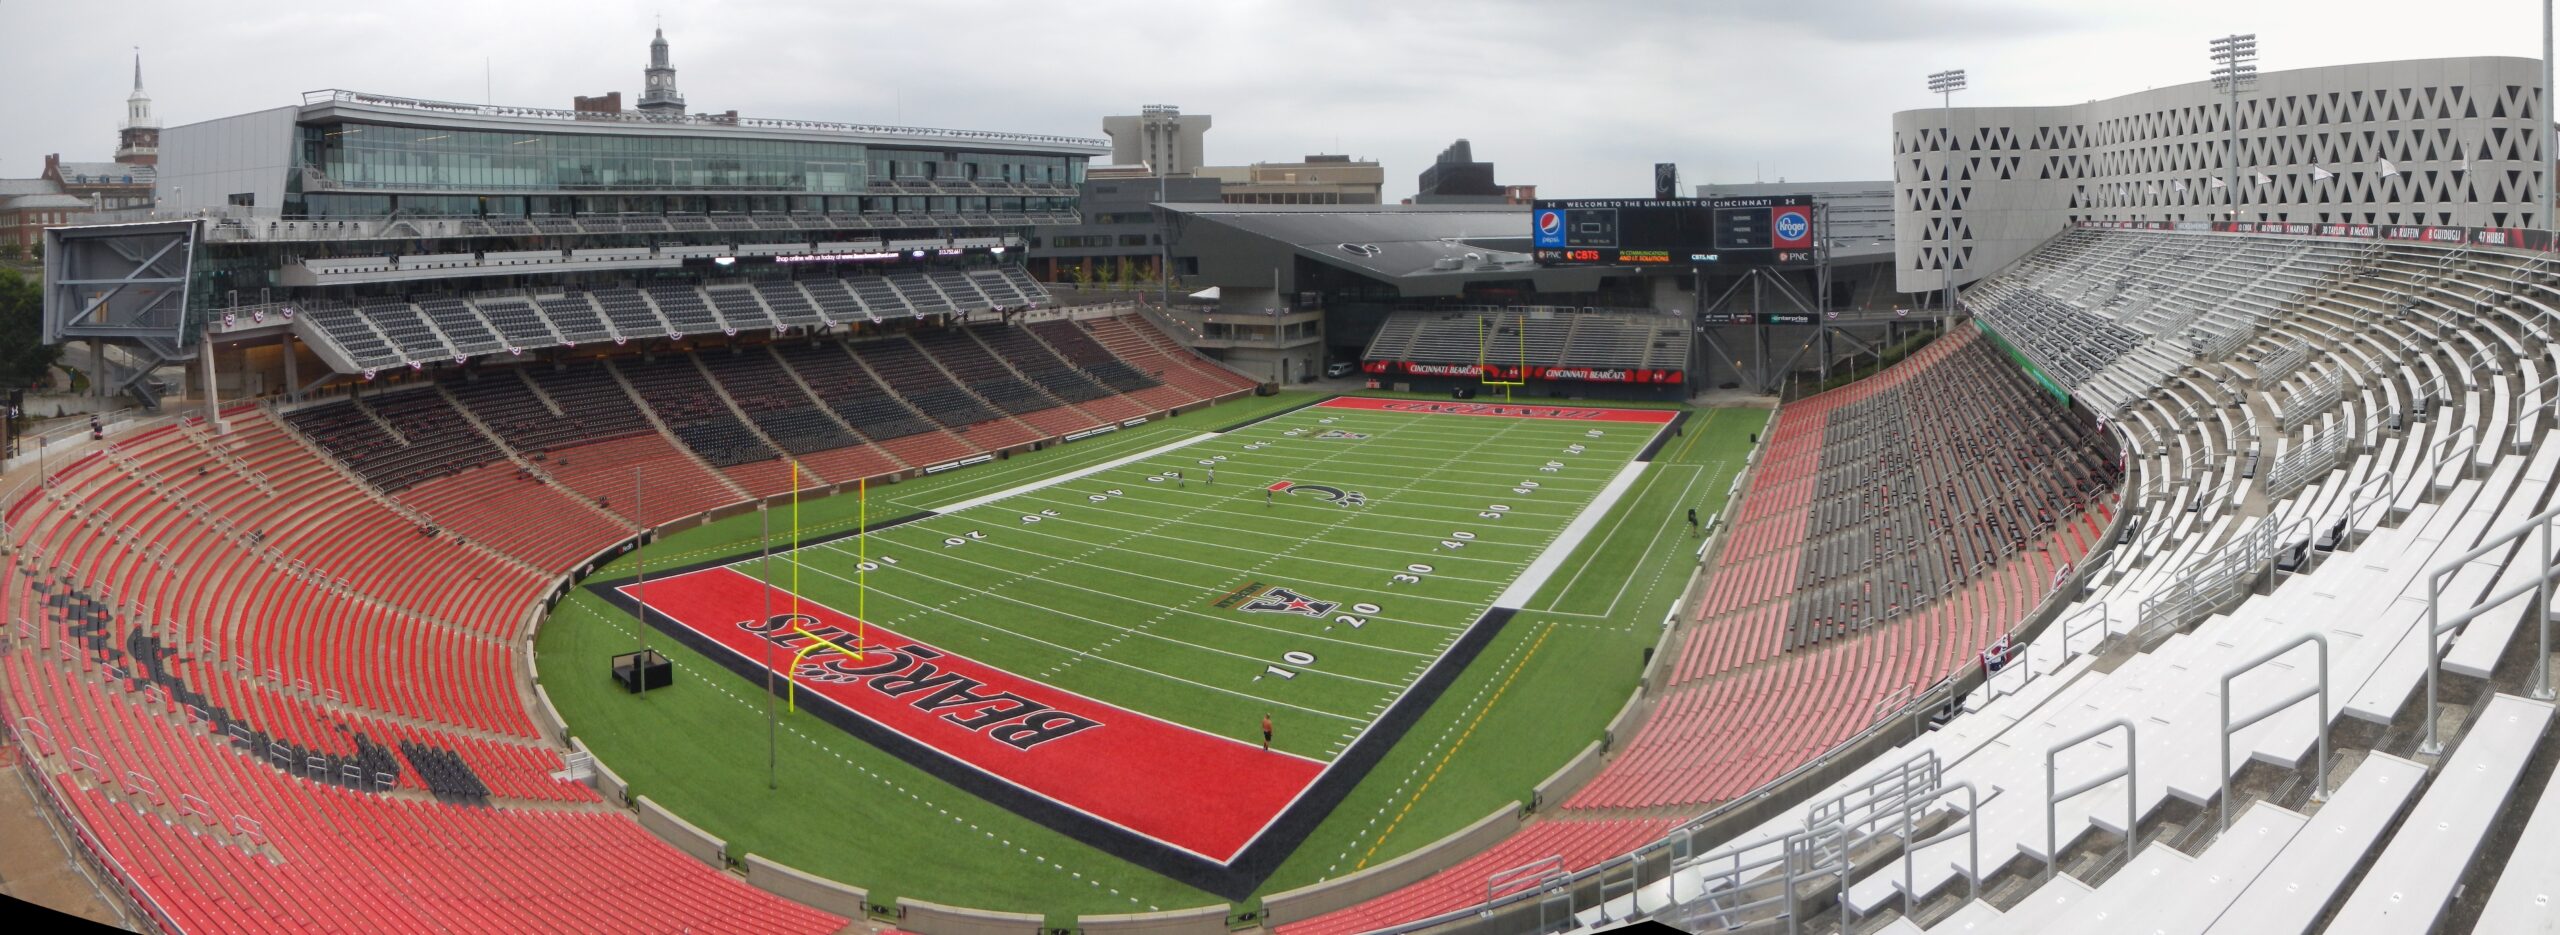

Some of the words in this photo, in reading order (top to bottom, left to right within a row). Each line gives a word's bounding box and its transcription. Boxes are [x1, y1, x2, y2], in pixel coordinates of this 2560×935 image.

[1714, 199, 1772, 207] CINCINNATI
[1780, 217, 1805, 237] Kroger
[2329, 227, 2345, 236] TAYLOR
[2399, 228, 2419, 238] RUFFIN
[2433, 229, 2461, 241] GUIDUGLI
[2478, 231, 2485, 242] 47
[2486, 232, 2505, 244] HUBER
[775, 255, 789, 263] Shop
[1546, 251, 1561, 259] PNC
[1574, 250, 1599, 260] CBTS
[1789, 252, 1808, 260] PNC
[1410, 364, 1448, 374] CINCINNATI
[1449, 364, 1483, 375] BEARCATS
[1546, 369, 1588, 379] CINCINNATI
[1589, 370, 1626, 381] BEARCATS
[1440, 530, 1477, 551] 40
[1393, 563, 1434, 585] 30
[1335, 602, 1383, 629] 20
[1264, 651, 1318, 680] 10
[736, 613, 1106, 752] BEARCATS
